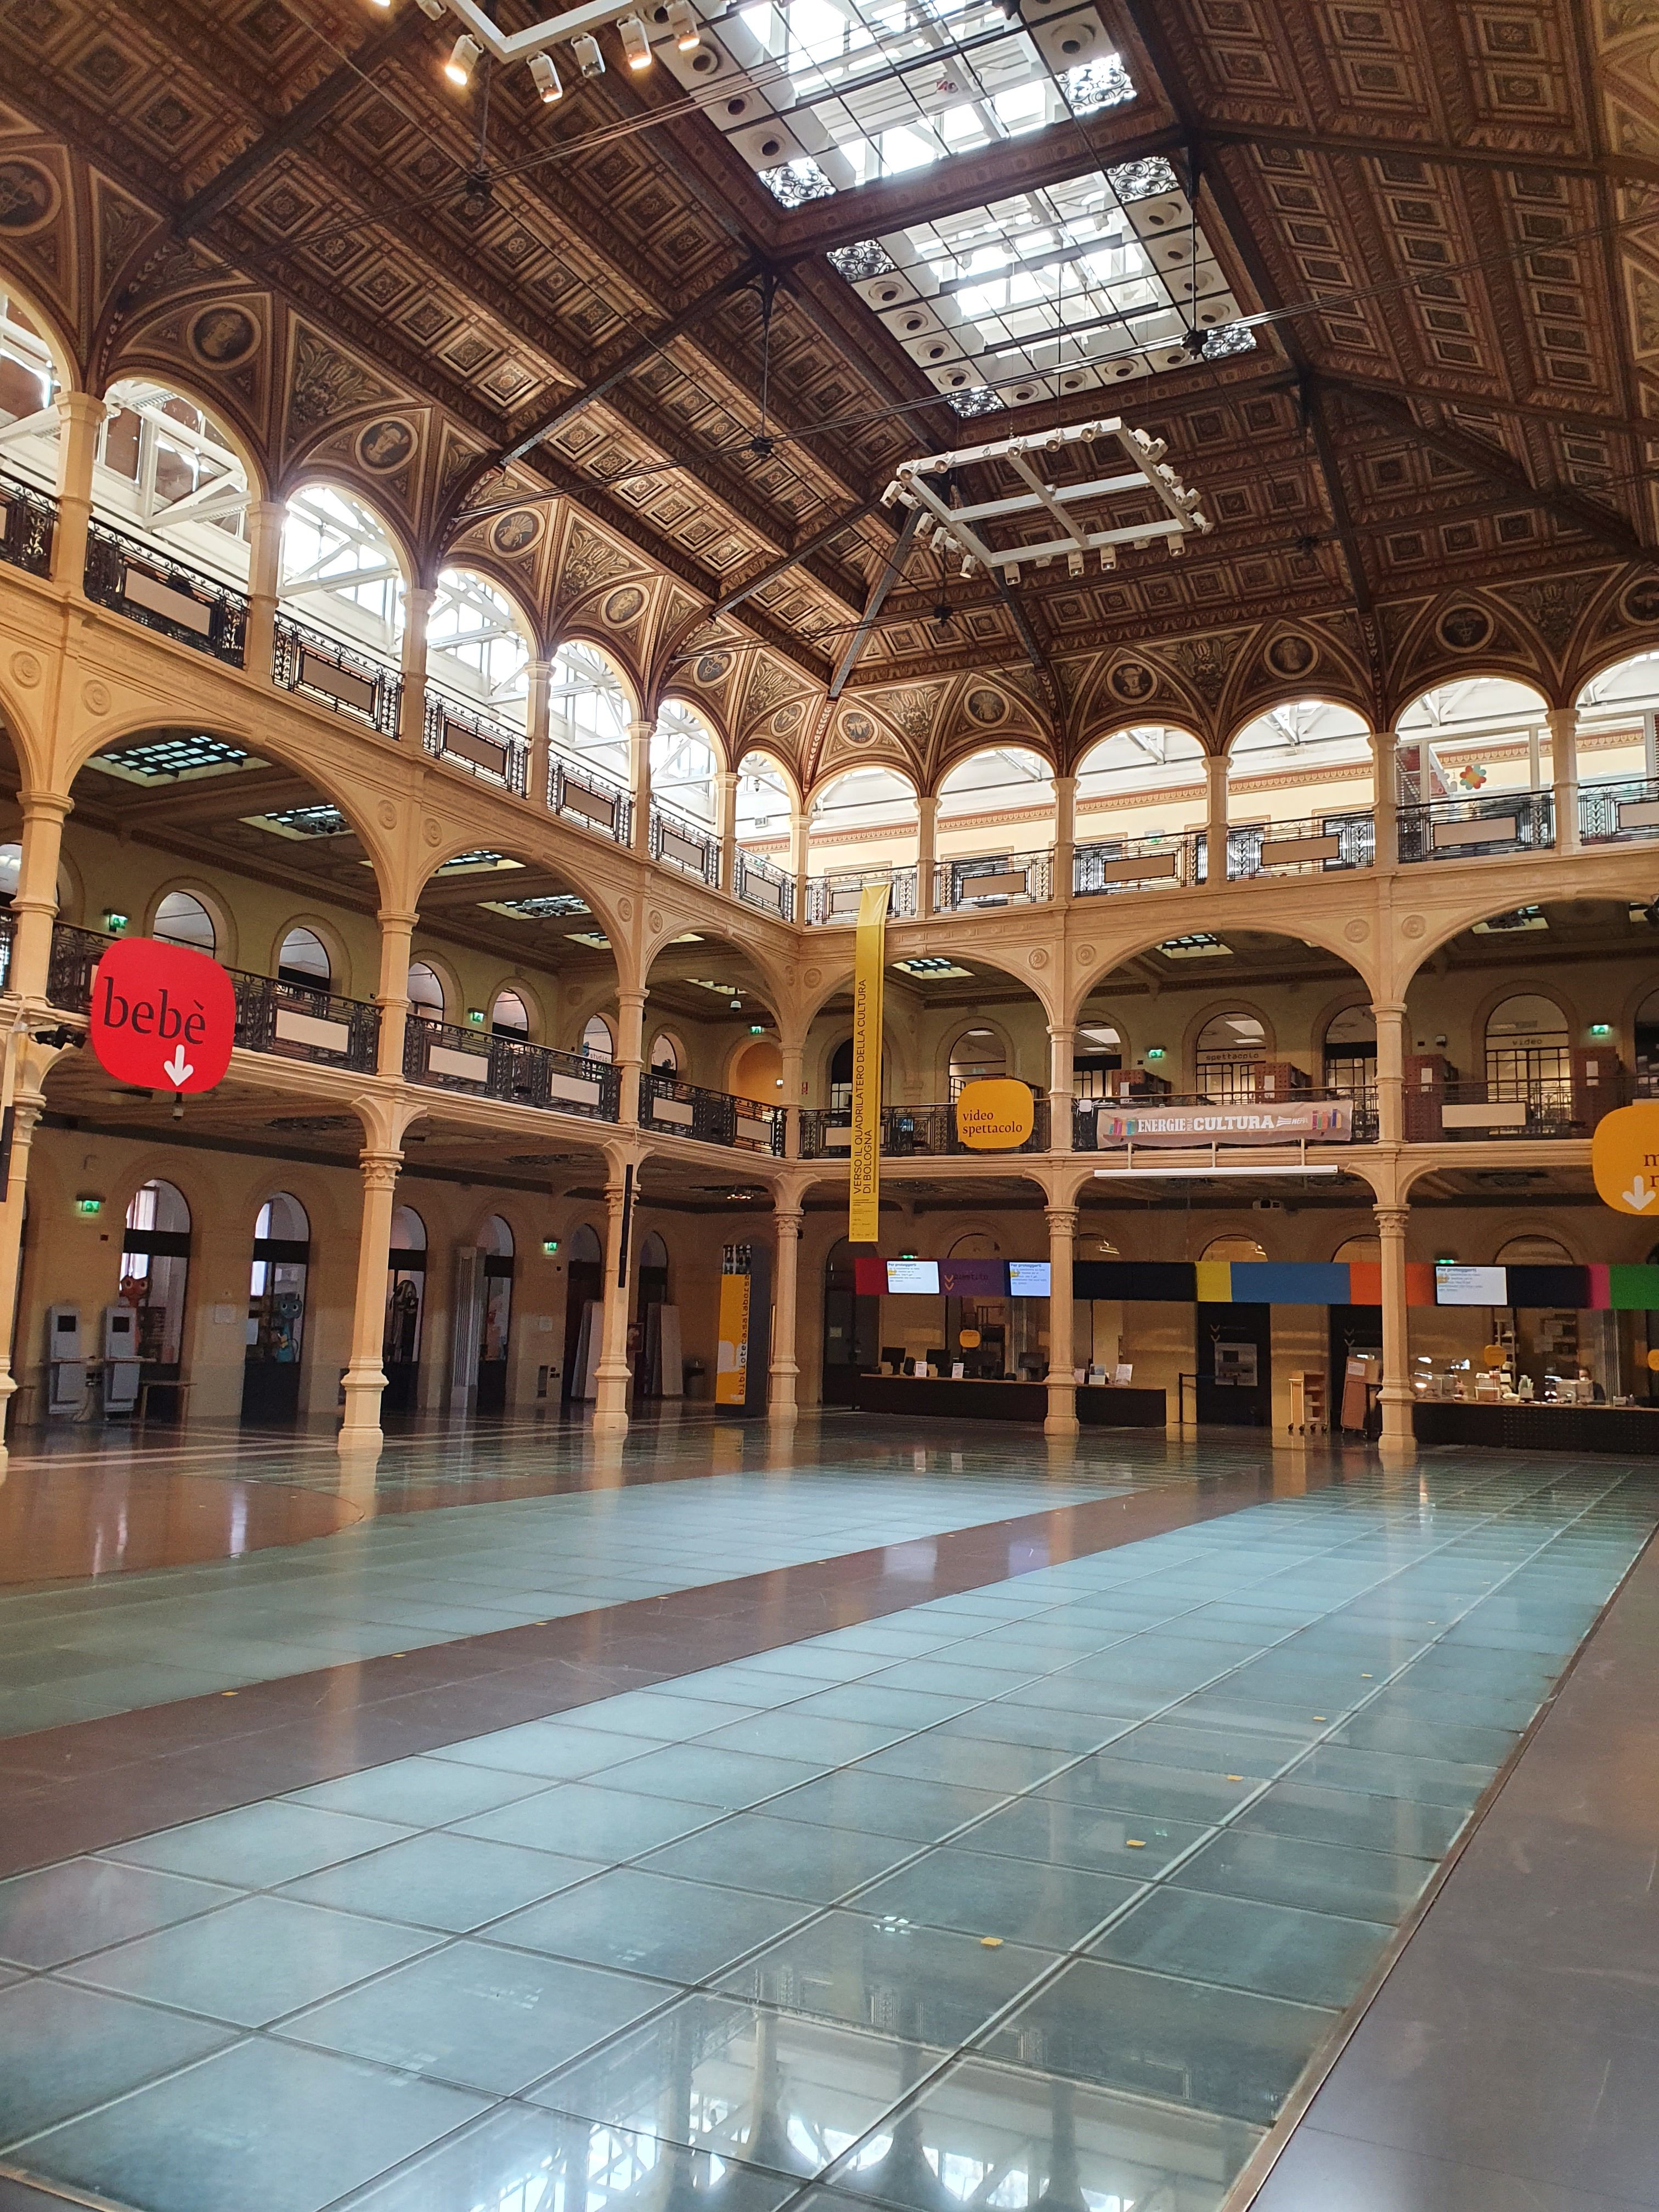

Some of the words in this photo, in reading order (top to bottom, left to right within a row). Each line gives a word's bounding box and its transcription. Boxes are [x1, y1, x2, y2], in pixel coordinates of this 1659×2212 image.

[103, 977, 206, 1045] bebè
[858, 979, 867, 1027] CULTURA
[856, 1030, 865, 1062] DELLA
[1206, 1053, 1259, 1061] spettacolo
[854, 1065, 864, 1145] QUADRILATERO
[963, 1109, 994, 1121] video
[963, 1121, 1023, 1137] spettacolo
[1137, 1118, 1186, 1132] ENERGIE
[1193, 1115, 1275, 1131] CULTURA
[854, 1148, 862, 1156] IL
[864, 1129, 873, 1181] BOLOGNA
[854, 1159, 862, 1194] VERSO
[864, 1183, 871, 1194] DI
